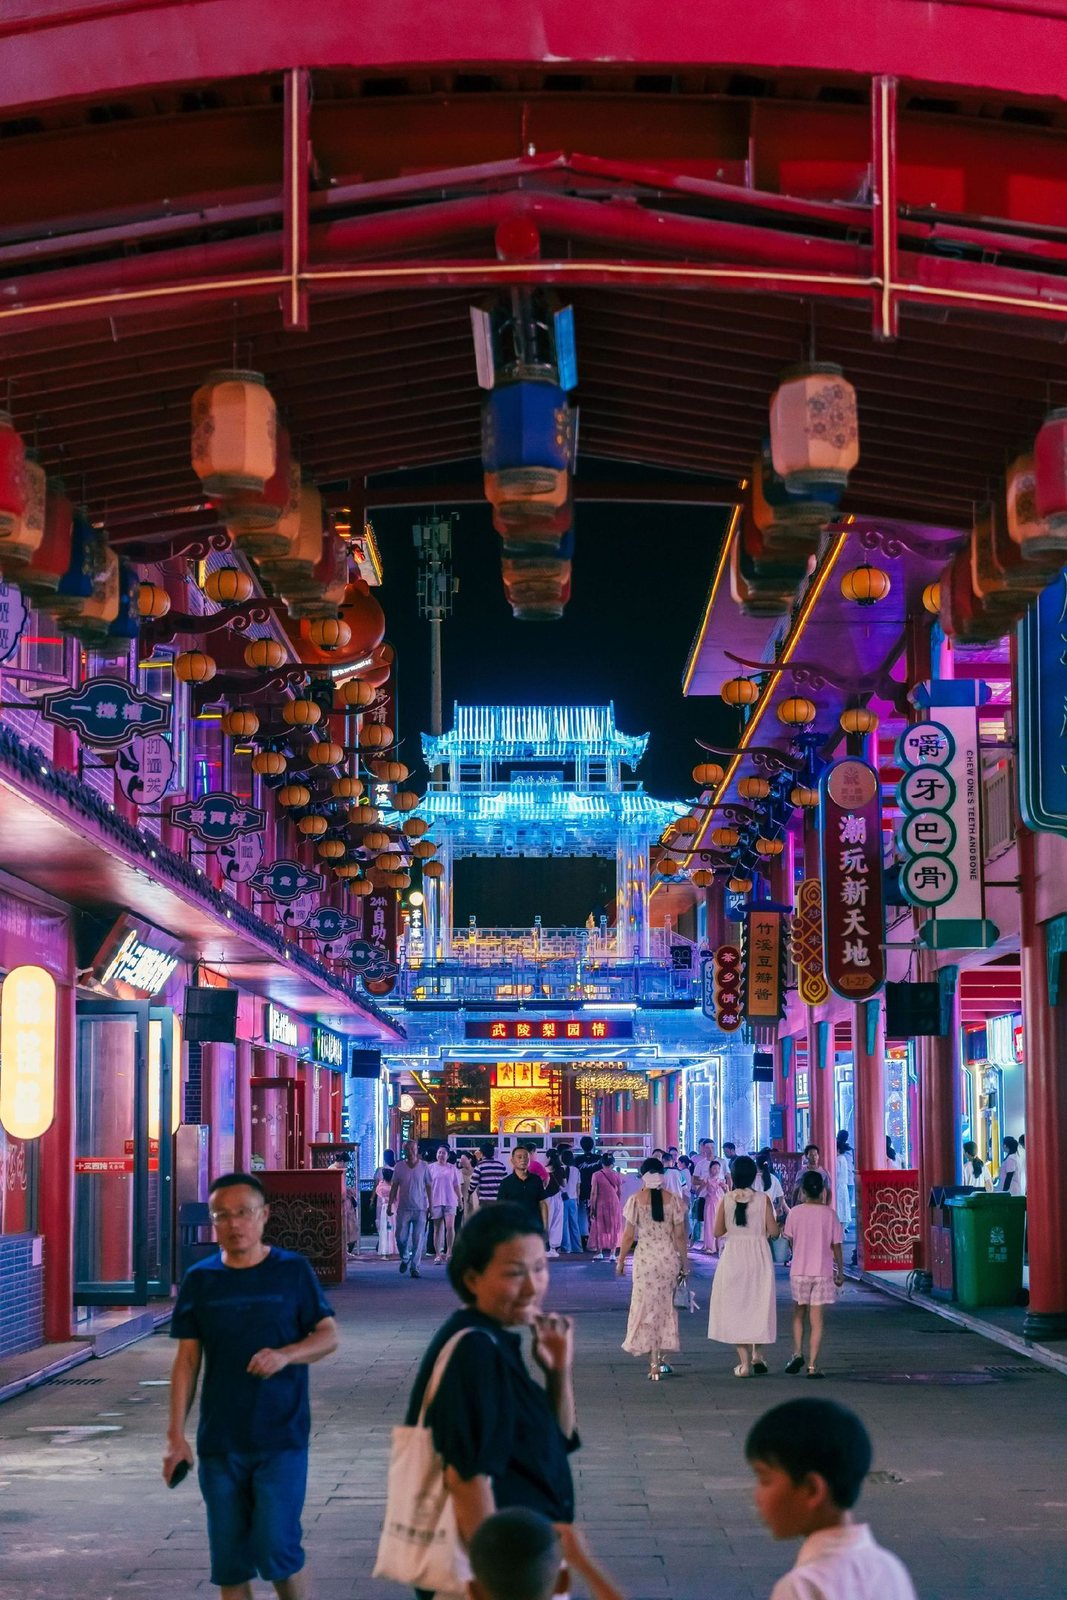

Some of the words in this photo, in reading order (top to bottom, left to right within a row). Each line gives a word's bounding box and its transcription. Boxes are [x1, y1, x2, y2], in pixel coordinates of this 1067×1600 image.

[966, 750, 974, 776] CHEW
[909, 734, 946, 891] 嚼牙巴骨
[968, 807, 976, 834] TEETH
[969, 836, 977, 851] AND
[370, 896, 388, 906] 24h
[839, 814, 871, 967] 潮玩新天地
[755, 922, 774, 1001] 竹溪豆瓣酱
[721, 952, 737, 1024] 茶乡情缘
[492, 1022, 606, 1037] 武陵梨园情
